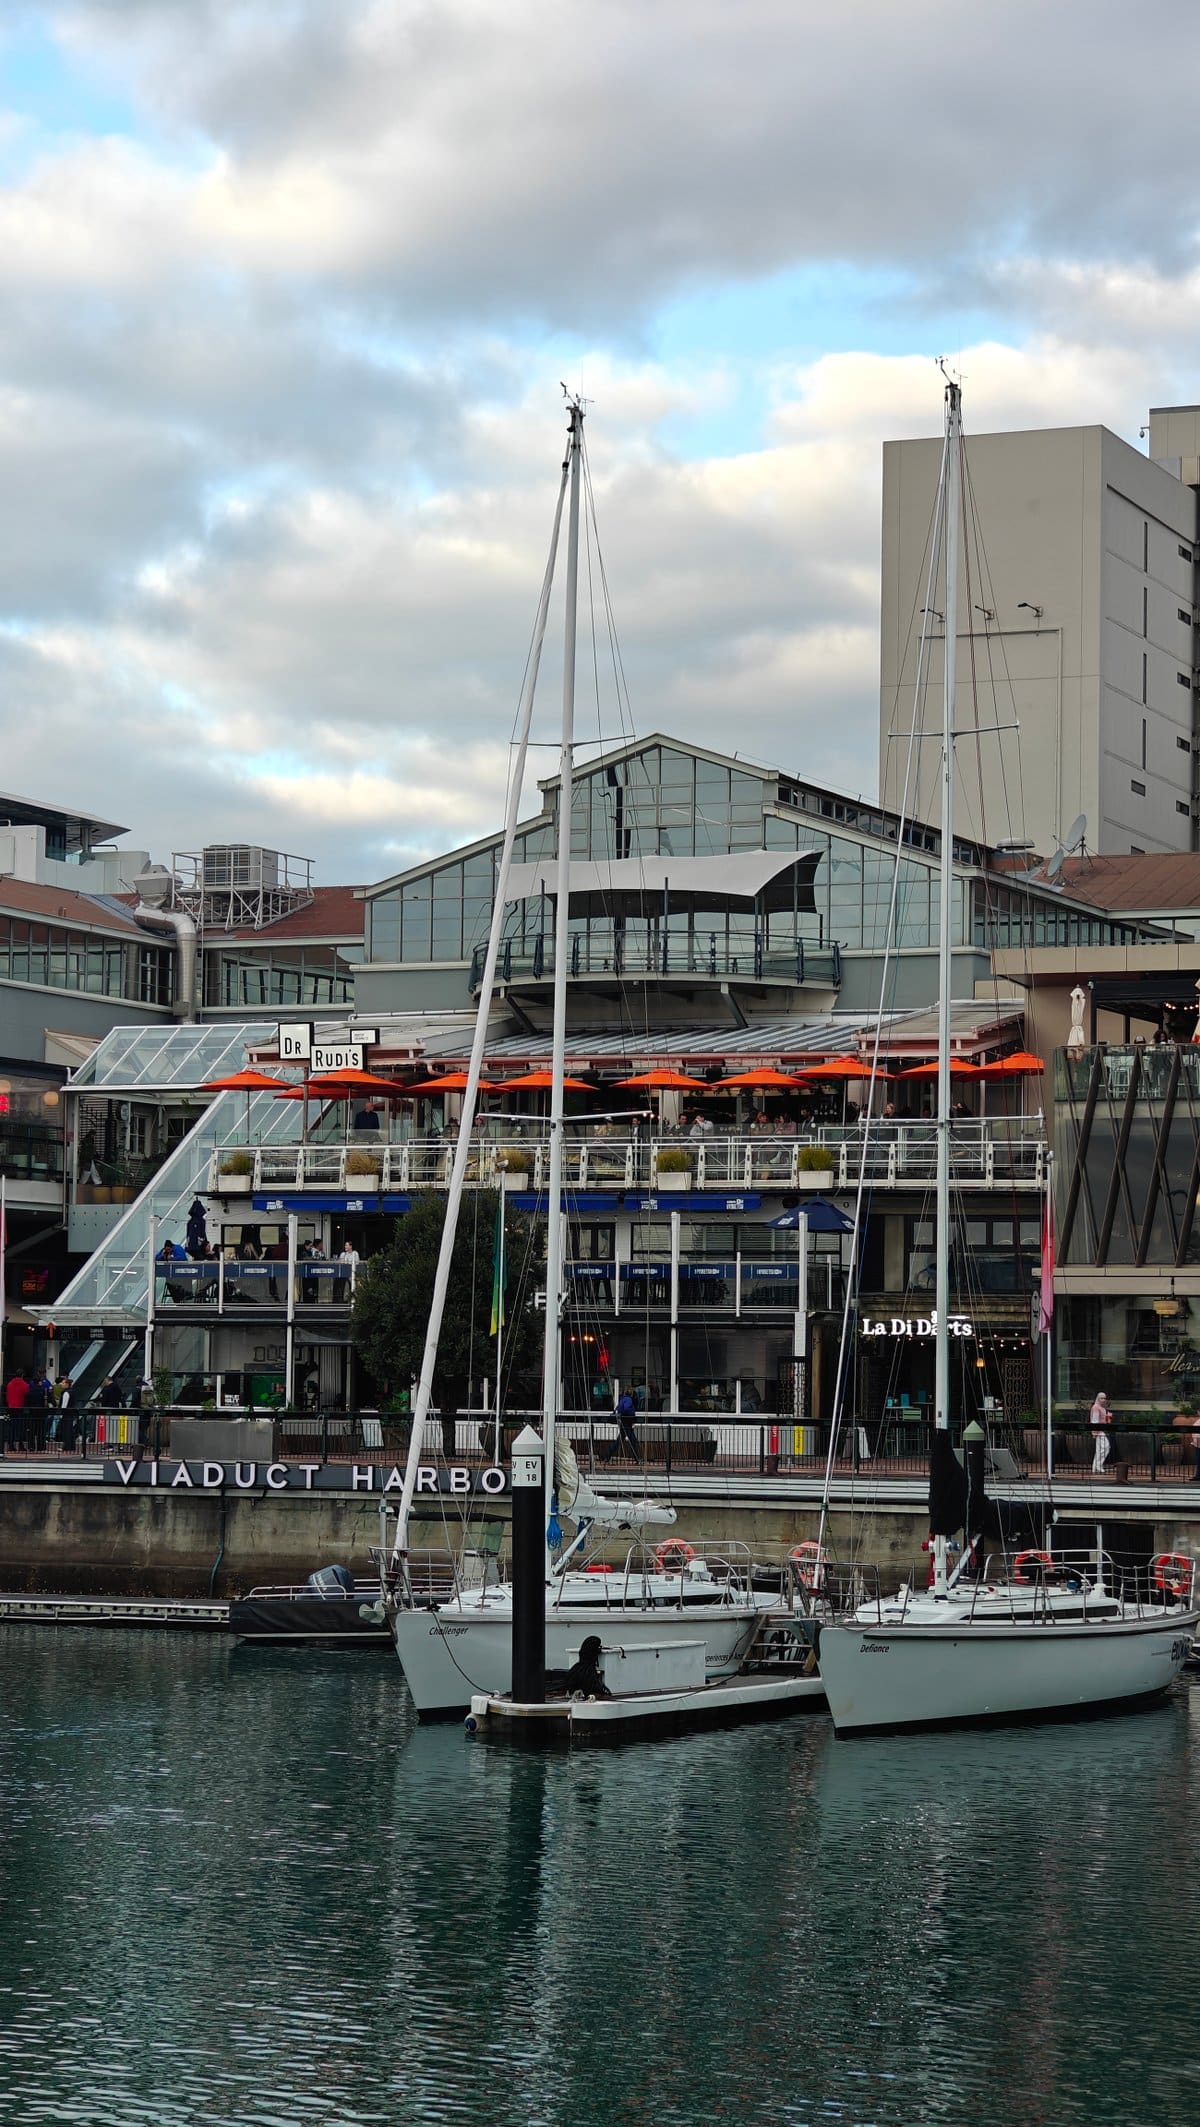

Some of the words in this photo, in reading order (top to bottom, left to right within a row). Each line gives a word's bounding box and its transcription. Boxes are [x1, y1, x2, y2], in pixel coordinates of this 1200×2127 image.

[862, 1319, 887, 1335] La
[891, 1319, 912, 1335] Di
[525, 1460, 537, 1469] EV
[115, 1460, 320, 1489] VIADUCT
[352, 1464, 506, 1493] HARBO
[526, 1473, 537, 1482] 18
[428, 1626, 469, 1637] Challenger
[860, 1643, 890, 1653] Defiance
